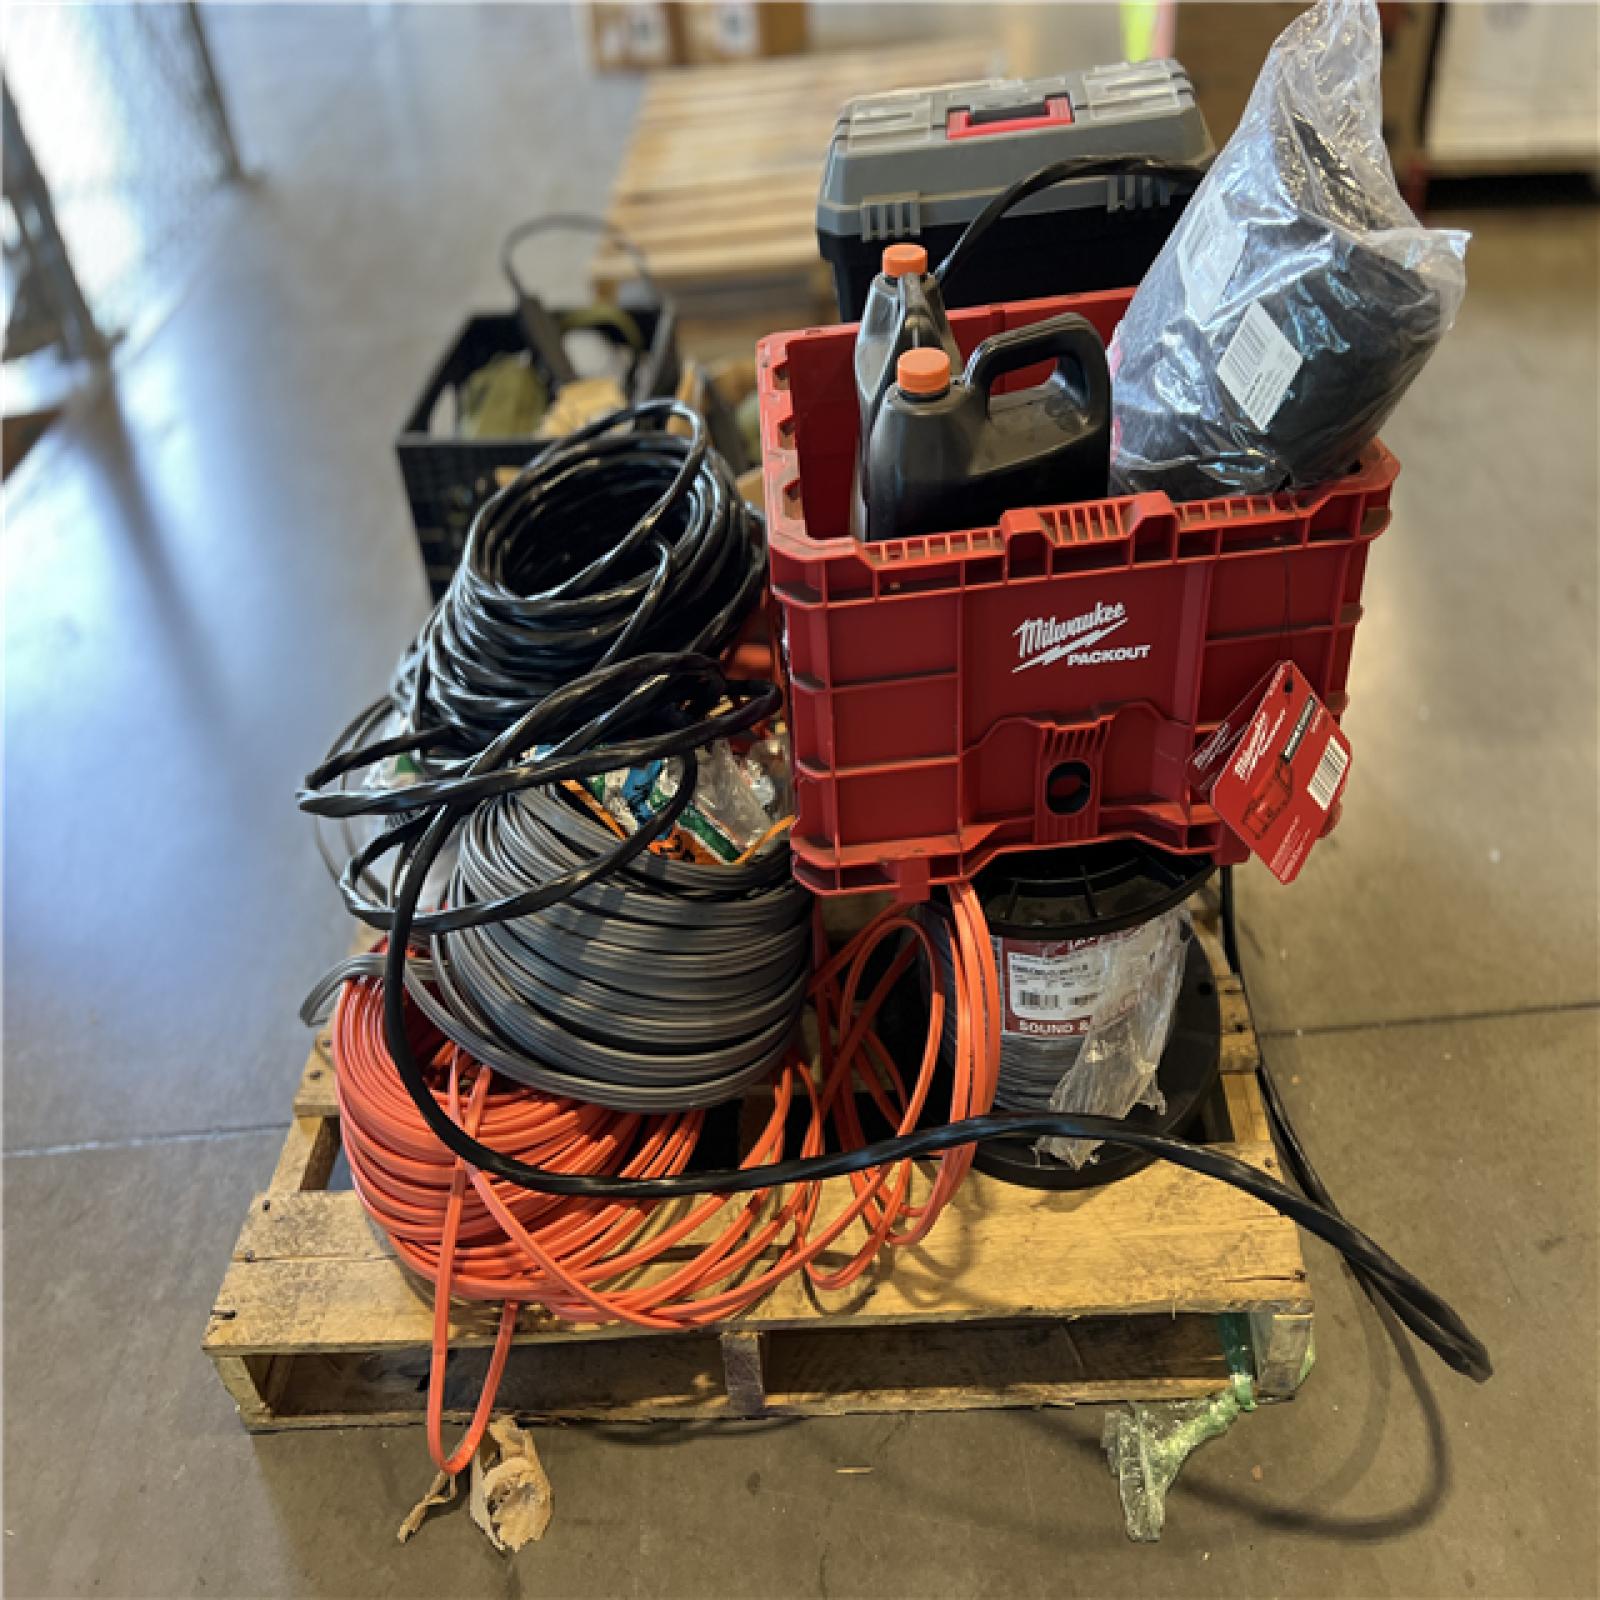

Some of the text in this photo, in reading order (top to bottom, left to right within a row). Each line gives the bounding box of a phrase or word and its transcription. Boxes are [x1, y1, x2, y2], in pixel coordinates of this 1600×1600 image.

[1012, 600, 1126, 658] Milwaukee
[1066, 645, 1151, 666] PACKOUT
[1019, 1020, 1074, 1033] SOUND
